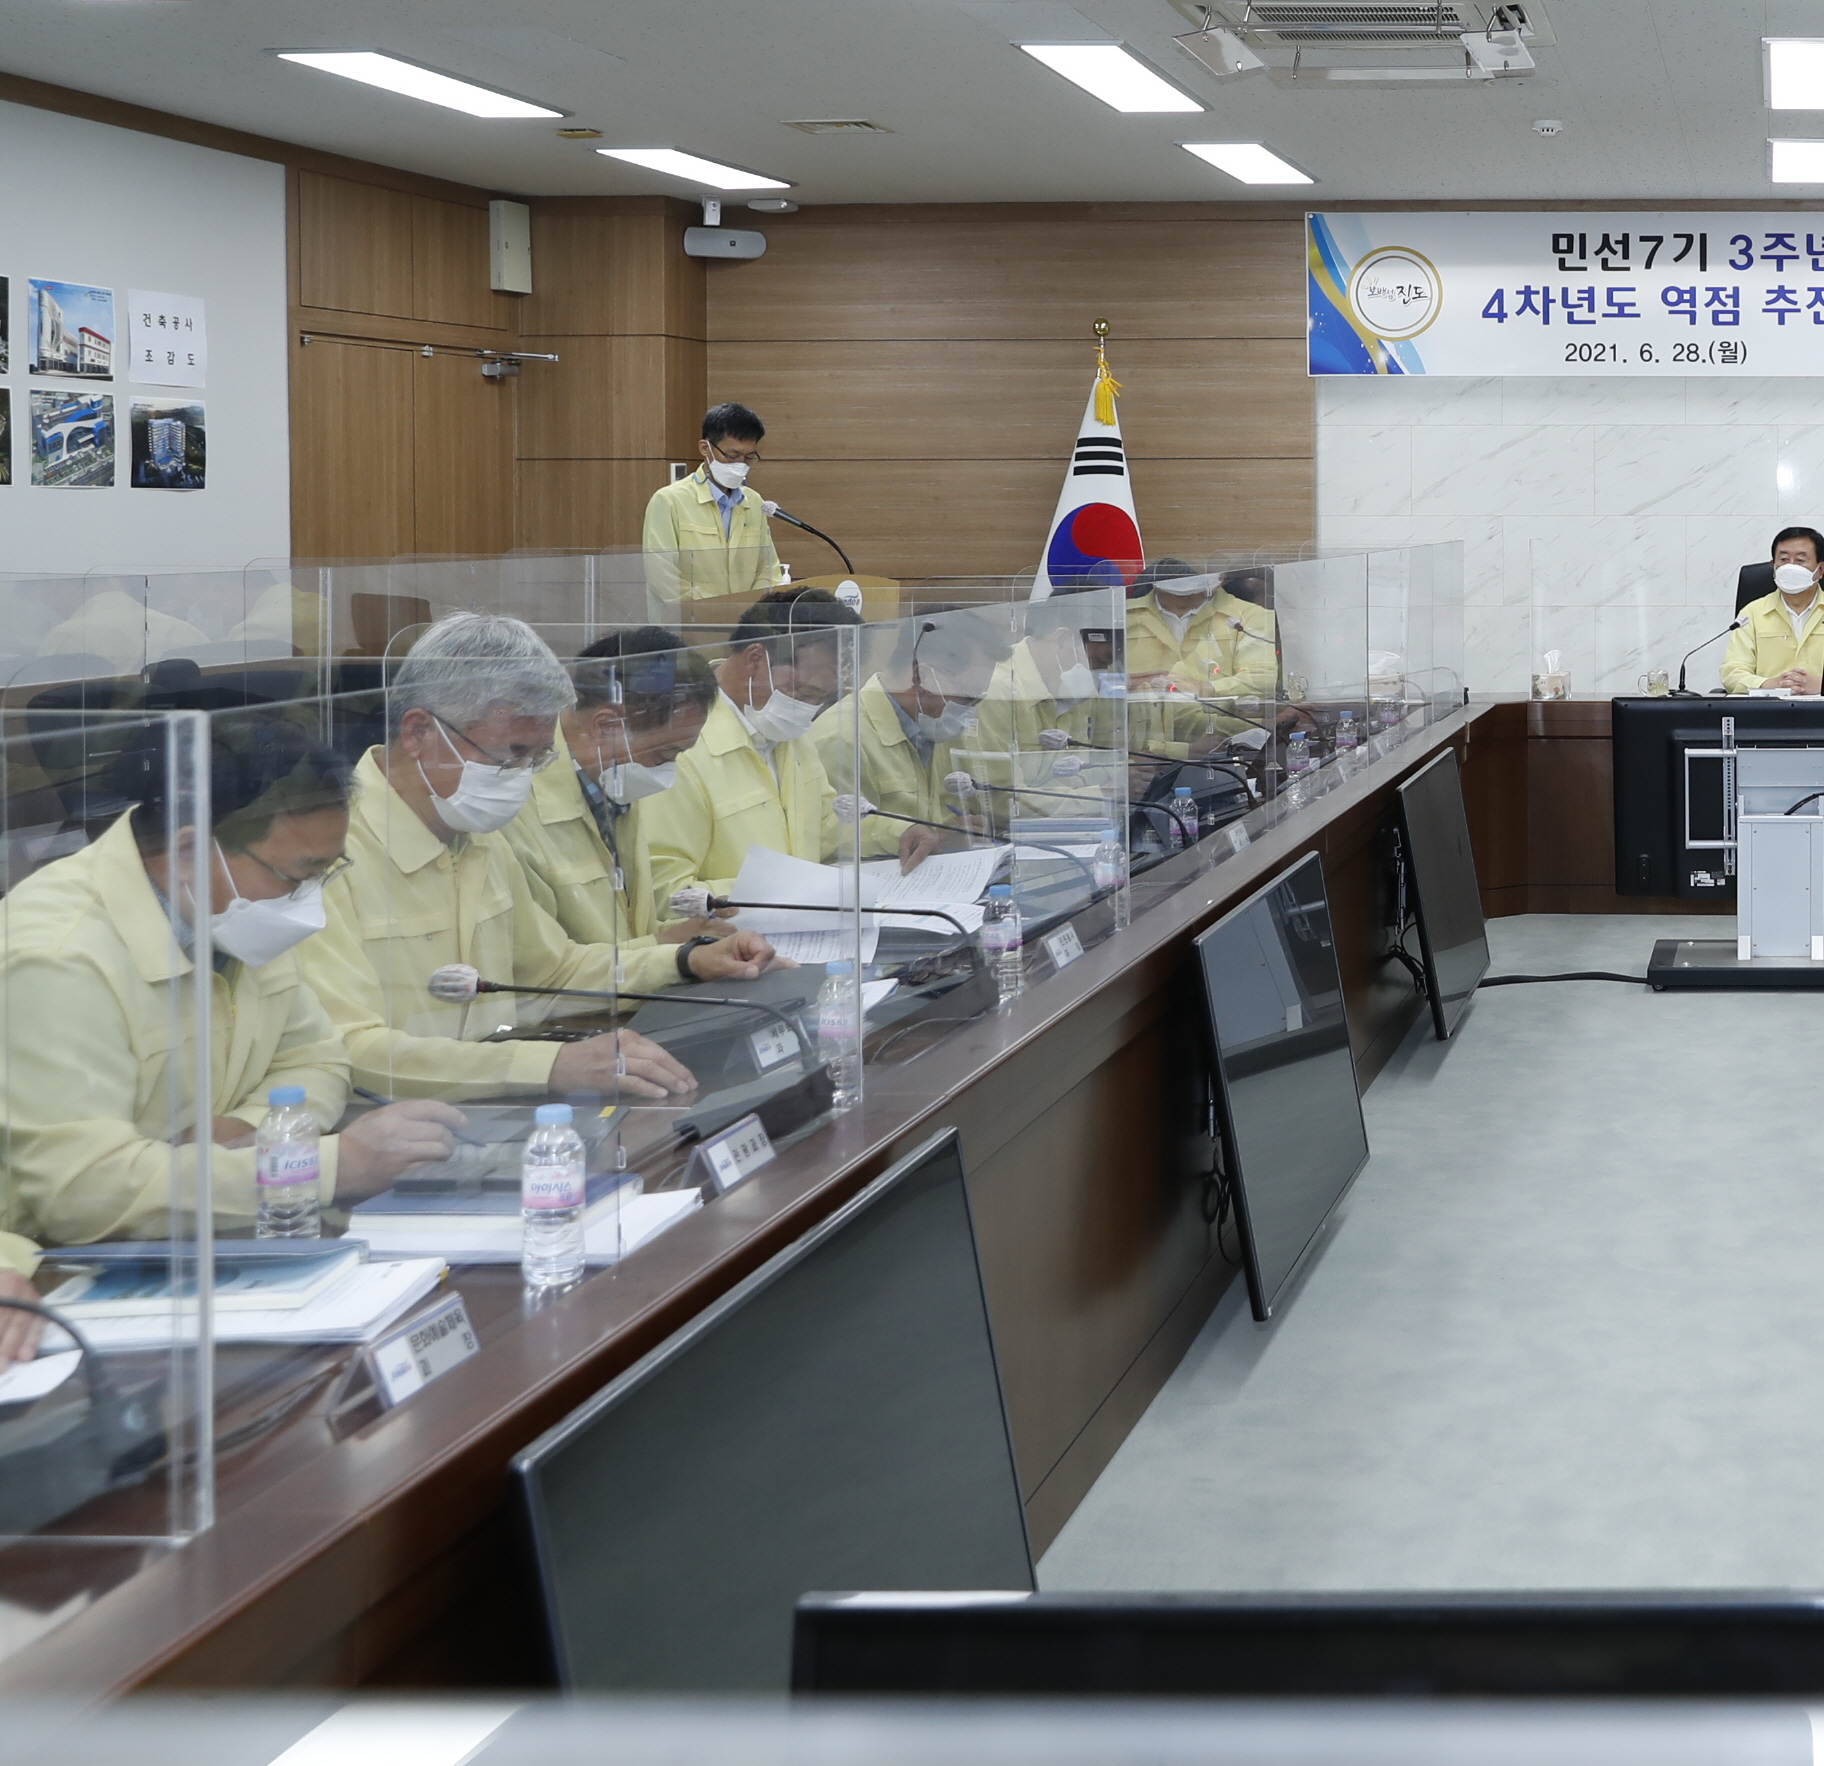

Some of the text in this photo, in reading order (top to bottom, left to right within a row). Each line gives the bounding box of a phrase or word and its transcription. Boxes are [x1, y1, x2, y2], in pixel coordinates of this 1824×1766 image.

[1552, 233, 1707, 271] 민선7기
[1482, 285, 1641, 325] 4차년도
[1661, 286, 1740, 325] 역점
[1565, 343, 1627, 363] 2021.
[1639, 343, 1660, 363] 6.
